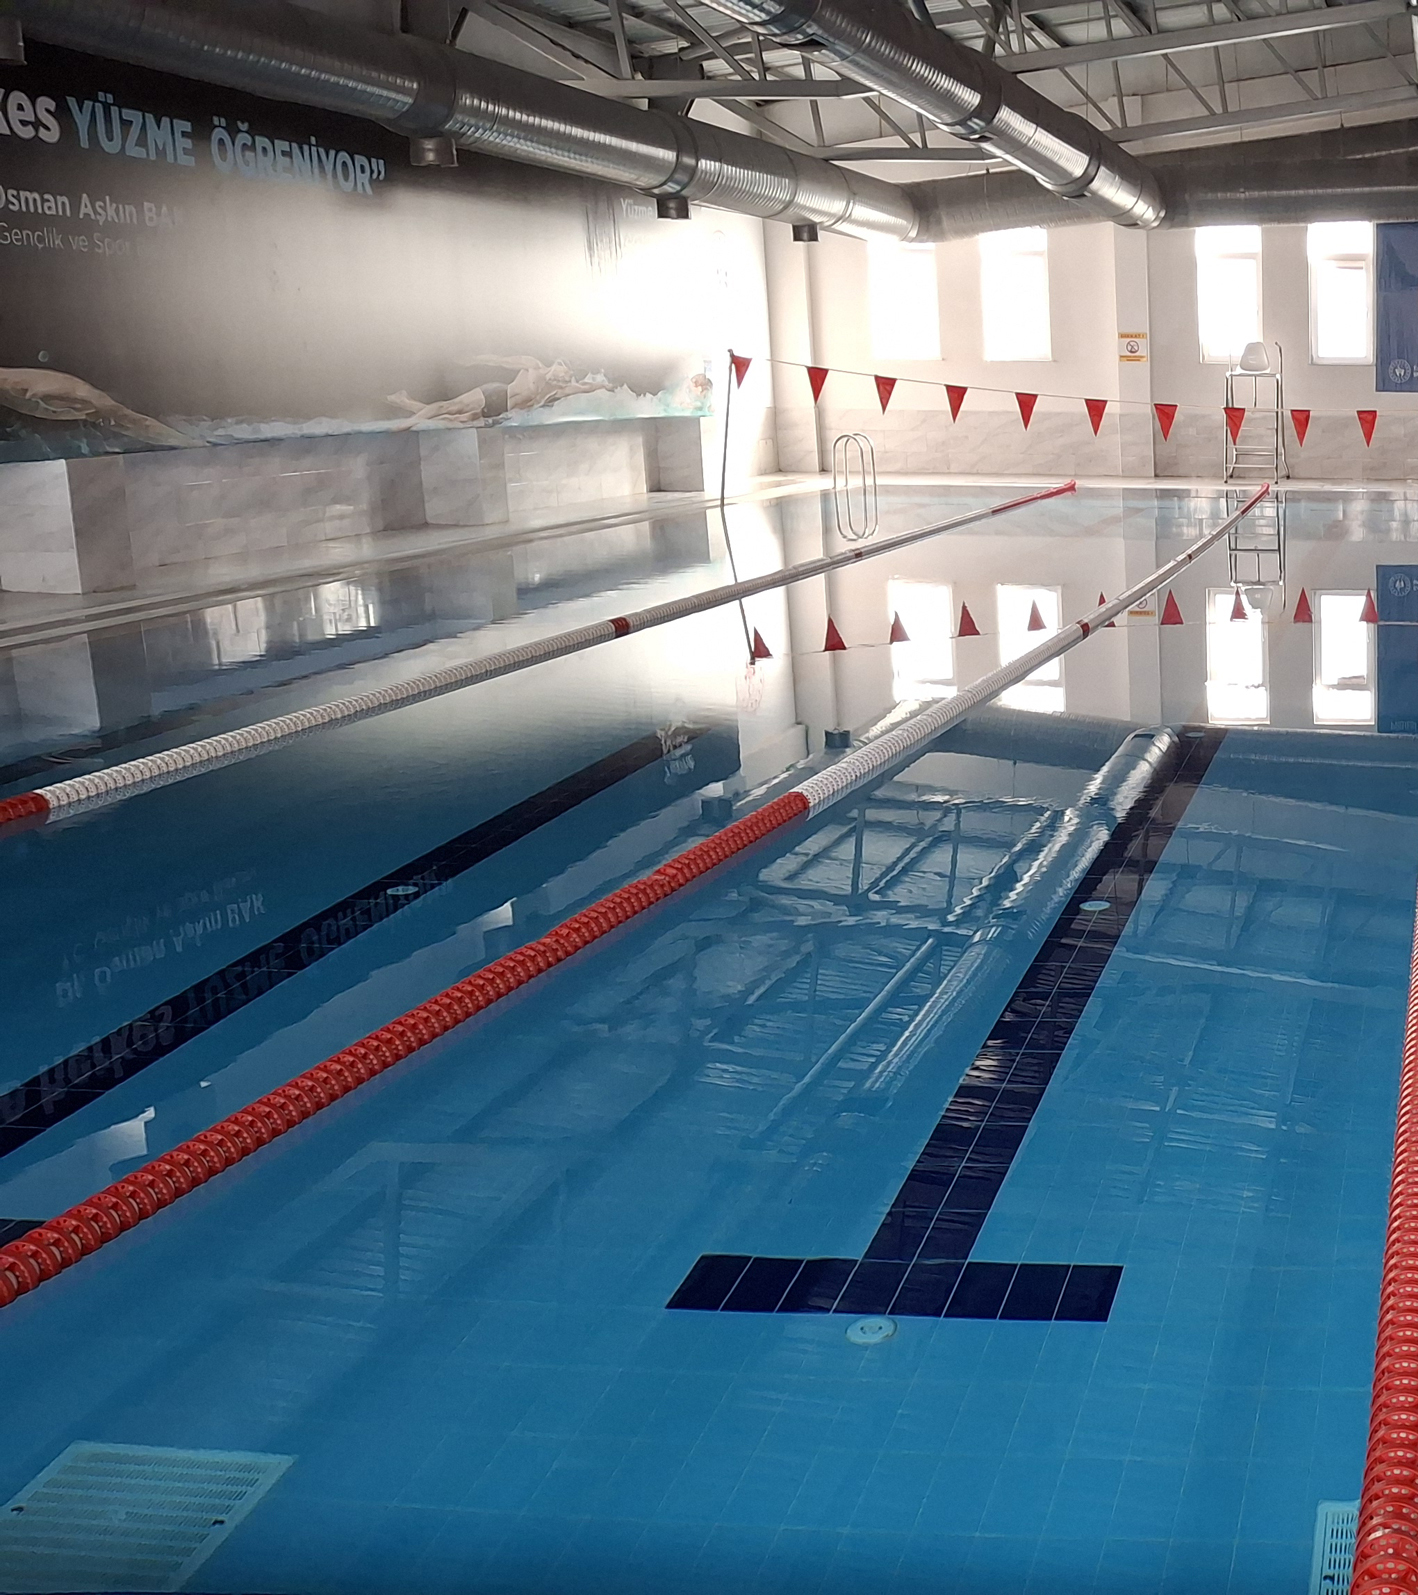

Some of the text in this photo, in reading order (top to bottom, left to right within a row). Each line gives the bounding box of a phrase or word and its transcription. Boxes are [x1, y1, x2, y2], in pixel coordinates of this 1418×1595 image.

[65, 91, 196, 167] YÜZME
[78, 193, 138, 226] Aşkın
[620, 197, 653, 218] Yüzme
[0, 222, 64, 251] Gençlik
[68, 235, 89, 253] ve
